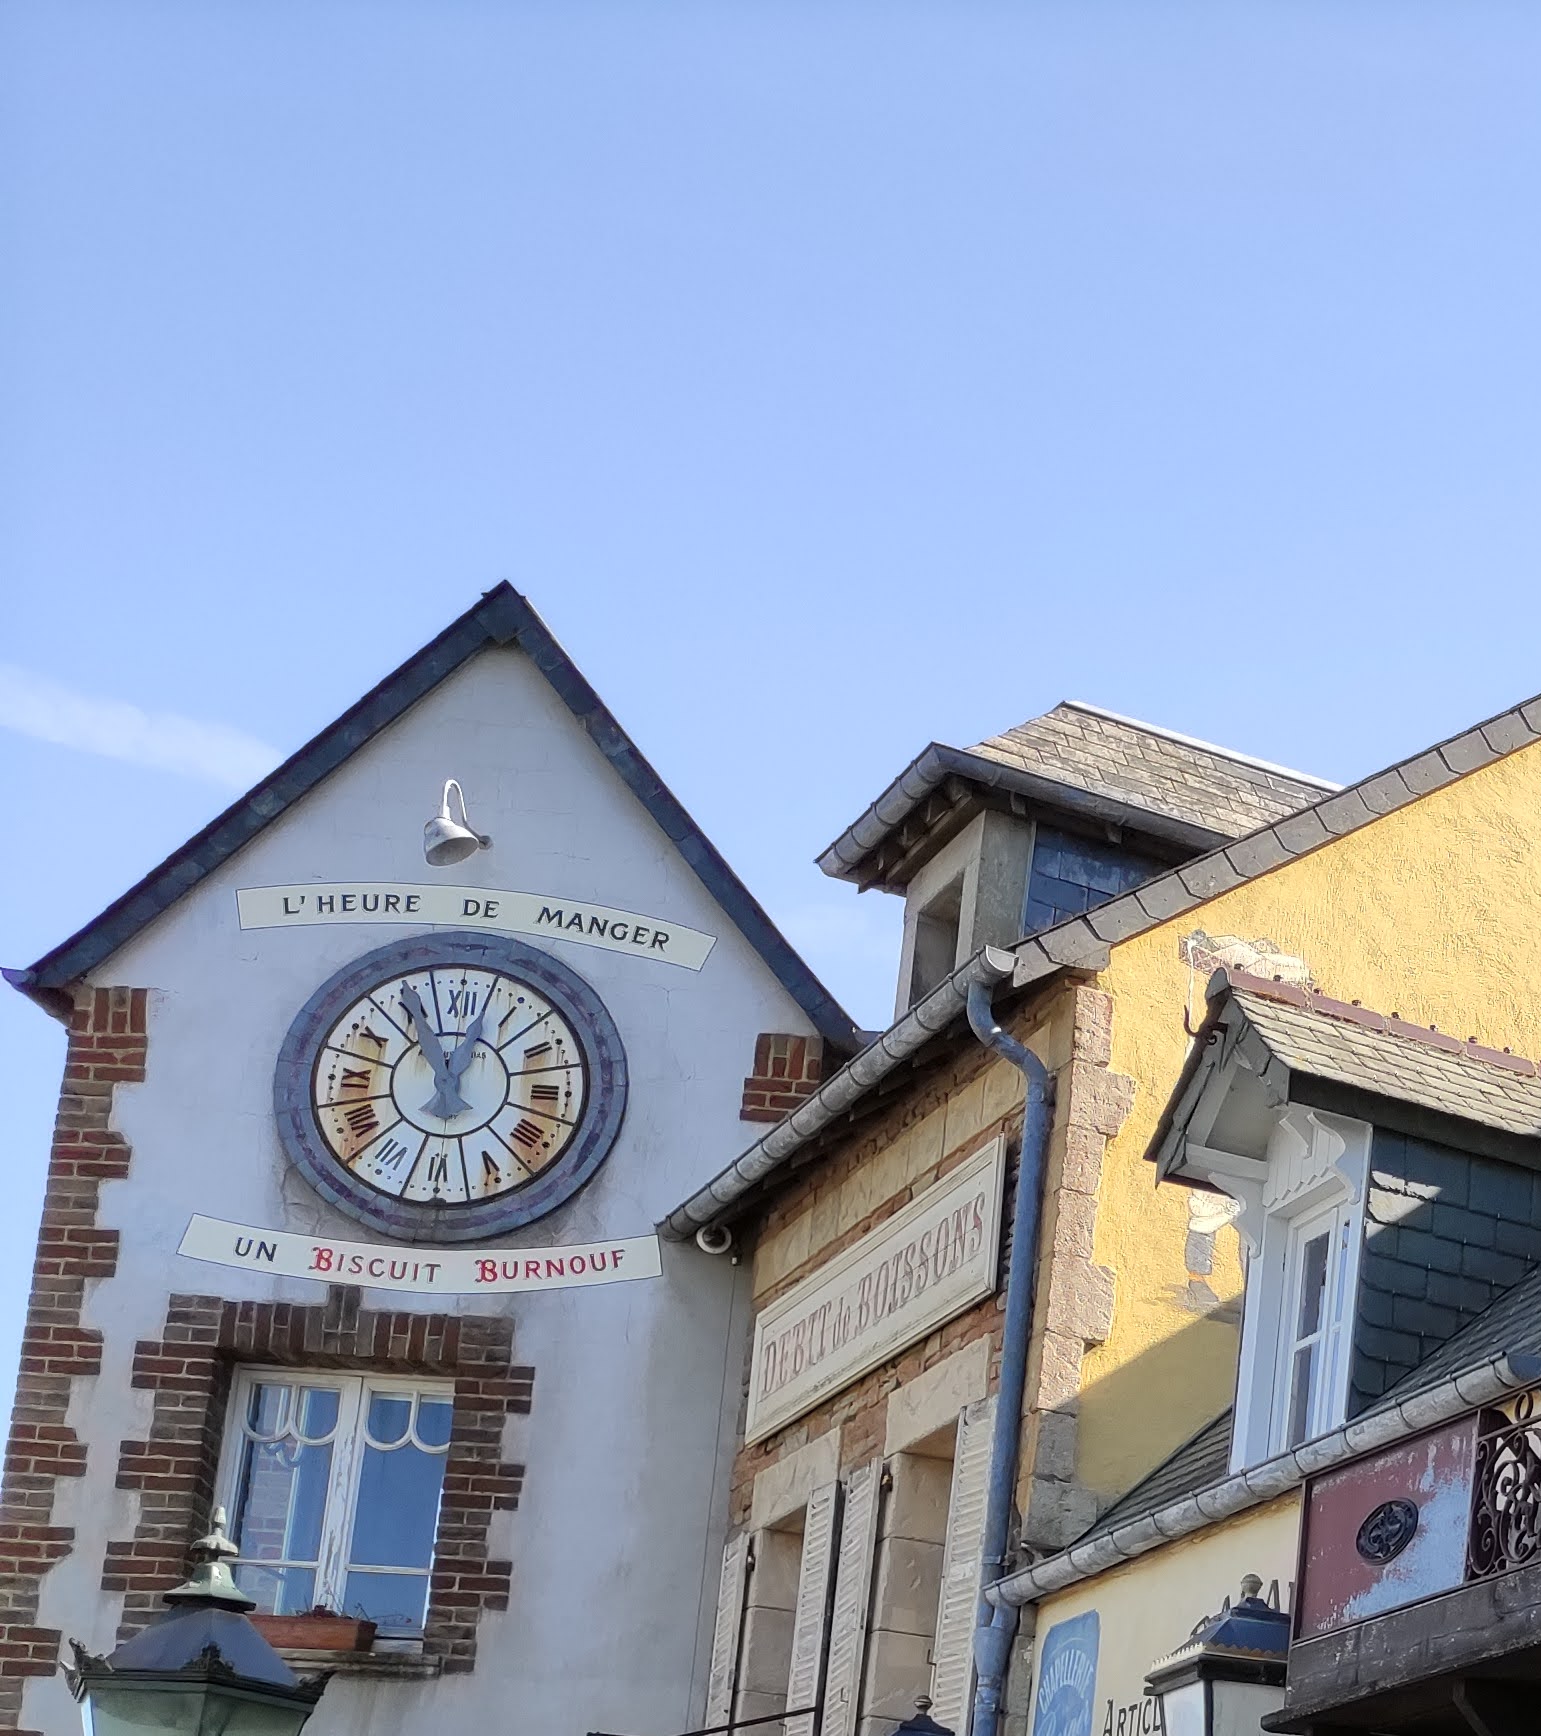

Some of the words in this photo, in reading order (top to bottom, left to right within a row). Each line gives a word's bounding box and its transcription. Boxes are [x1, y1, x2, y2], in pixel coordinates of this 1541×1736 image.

[283, 893, 421, 916] L'HEURE
[462, 898, 499, 918] DE
[536, 905, 671, 953] MANGER
[234, 1236, 278, 1262] UN
[763, 1300, 831, 1393] DEBIT
[833, 1296, 851, 1348] de
[855, 1191, 985, 1332] BOISSONS
